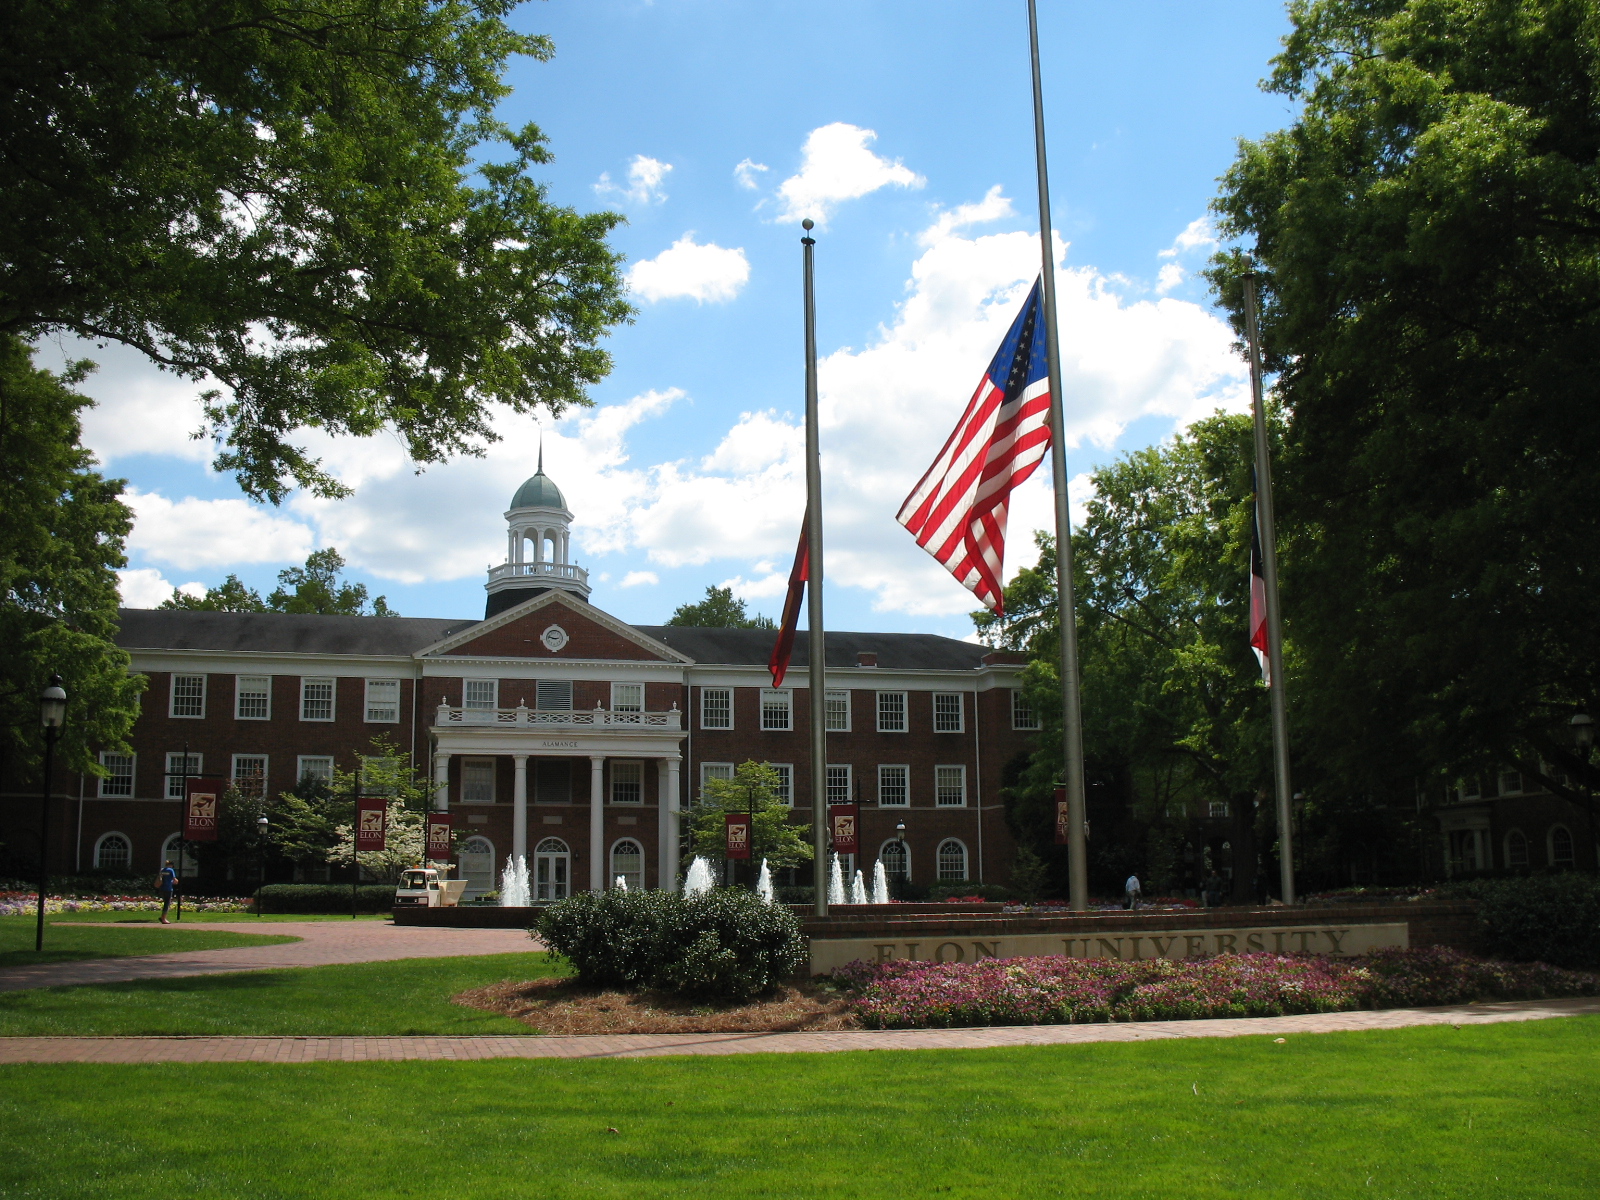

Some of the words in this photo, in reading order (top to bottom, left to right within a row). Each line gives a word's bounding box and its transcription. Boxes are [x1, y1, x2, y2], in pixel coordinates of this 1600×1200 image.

[188, 817, 215, 827] ELON
[359, 831, 382, 839] ELON
[834, 835, 854, 843] ELON
[429, 842, 449, 850] ELON
[873, 941, 1001, 964] ELON
[1061, 930, 1350, 960] UNIVERSITY
